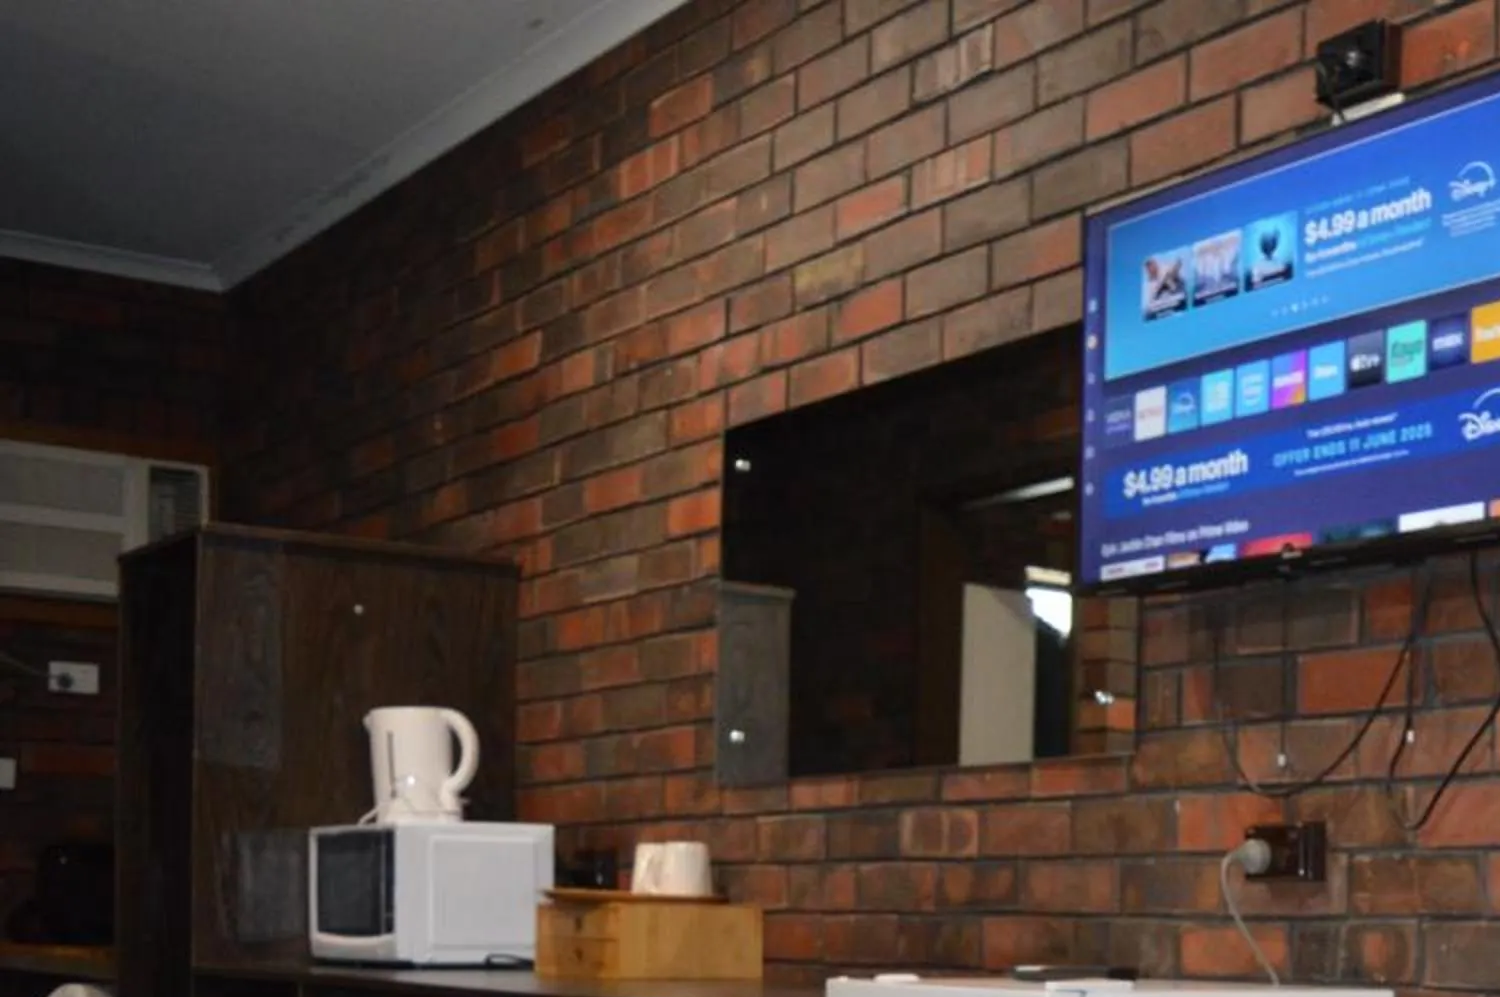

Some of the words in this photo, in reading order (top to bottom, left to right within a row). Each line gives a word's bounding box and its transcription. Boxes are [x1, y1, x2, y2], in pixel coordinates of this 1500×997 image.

[1305, 211, 1356, 246] $4.99
[1357, 208, 1369, 229] a
[1370, 186, 1432, 226] month
[1123, 464, 1173, 499] $4.99
[1175, 465, 1187, 487] a
[1188, 448, 1249, 483] month
